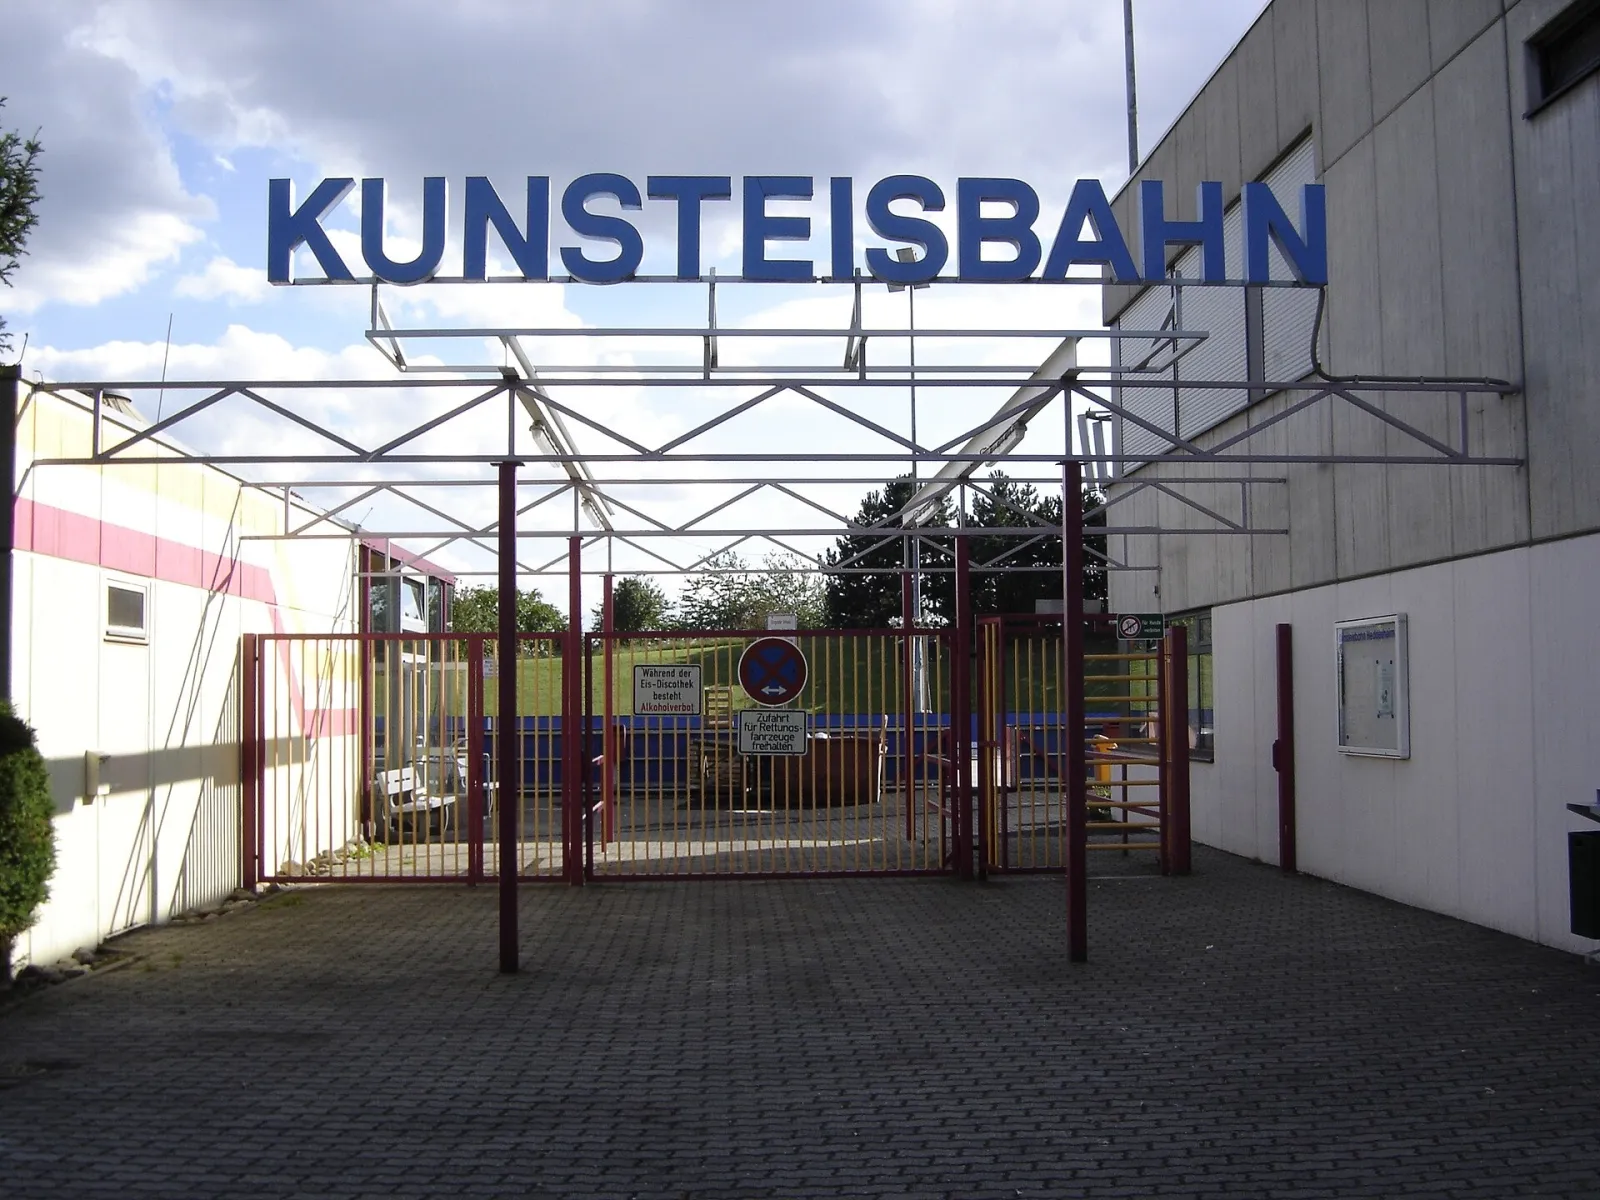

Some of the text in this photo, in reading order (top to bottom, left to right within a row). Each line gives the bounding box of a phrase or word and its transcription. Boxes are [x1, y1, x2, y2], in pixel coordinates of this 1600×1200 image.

[268, 173, 1328, 286] KUNSTEISBAHN
[641, 668, 692, 678] Während der
[640, 679, 694, 689] Eis-Discothek
[653, 691, 682, 700] besteht
[640, 702, 694, 712] Alkoholverbot
[756, 713, 790, 722] Zufahrt
[744, 722, 803, 732] für Rettungs-
[751, 732, 795, 743] fahrzeuge
[752, 741, 793, 751] freihalten
